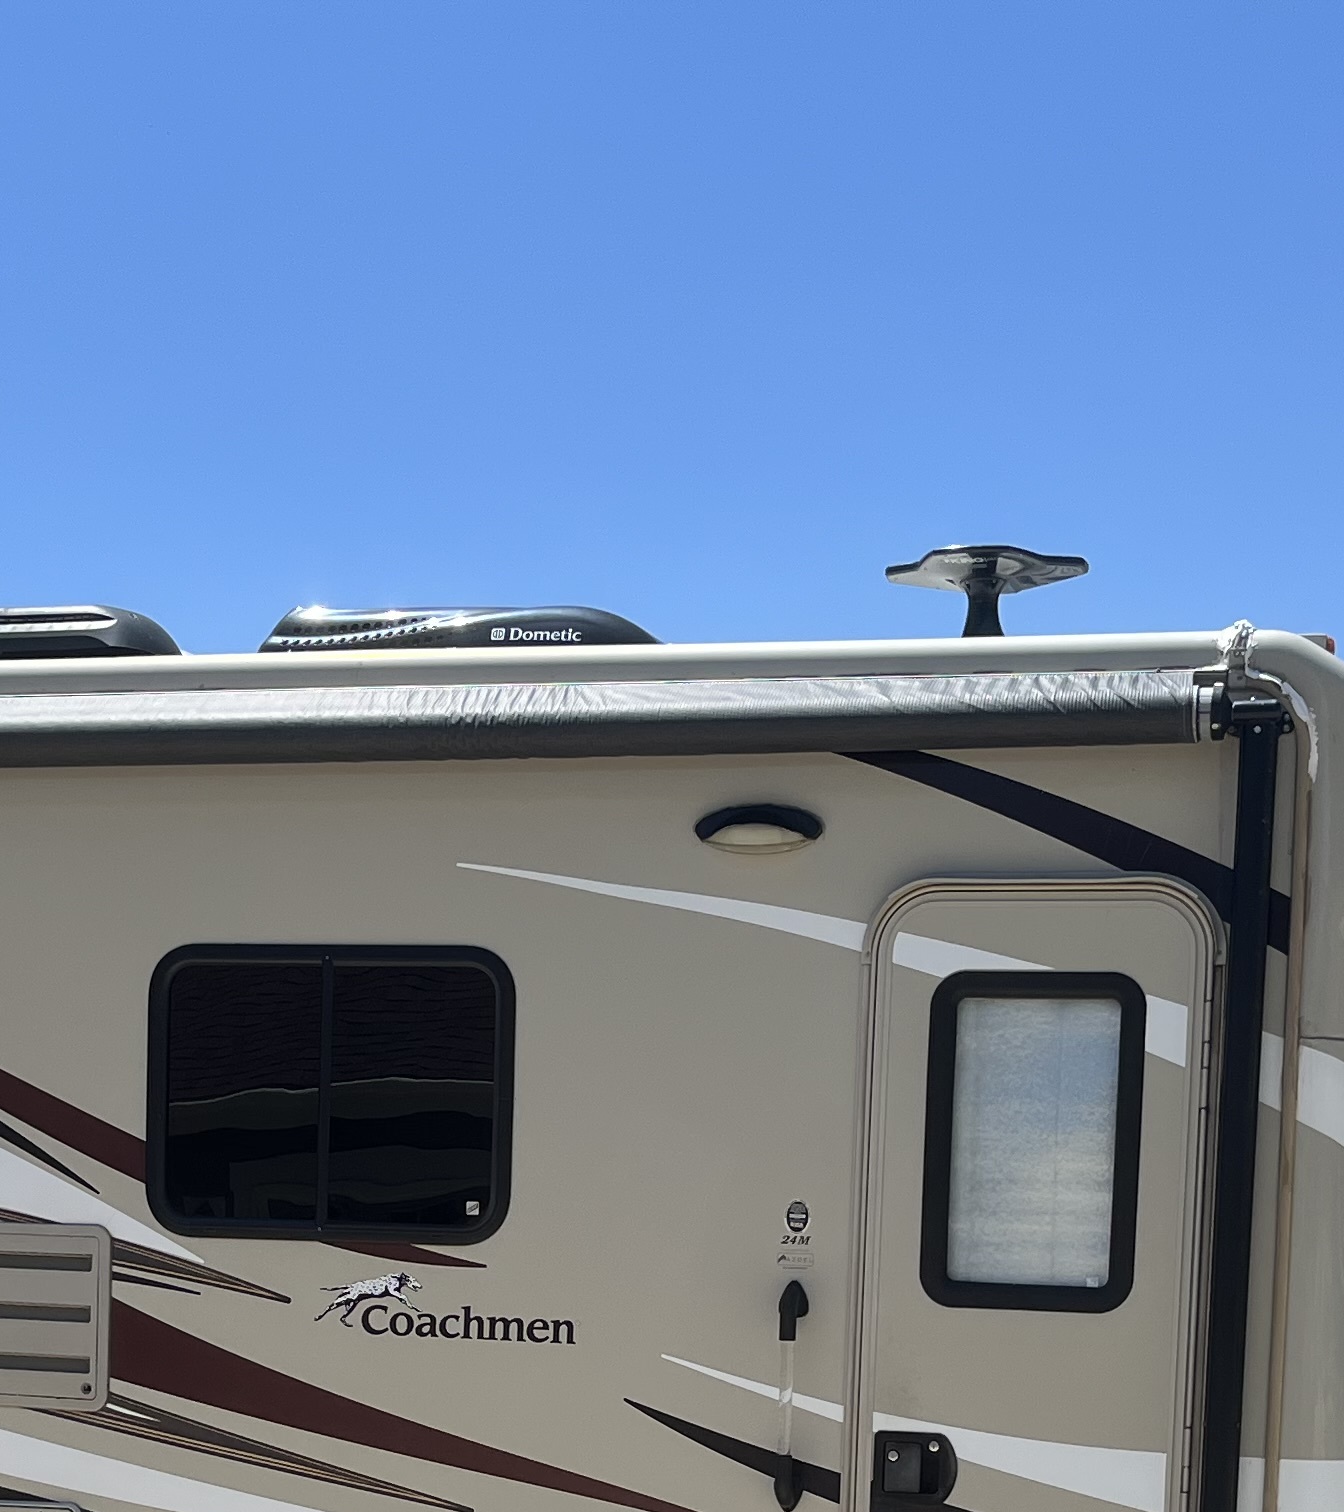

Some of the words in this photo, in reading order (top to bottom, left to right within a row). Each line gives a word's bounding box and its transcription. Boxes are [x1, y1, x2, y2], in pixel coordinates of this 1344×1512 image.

[509, 627, 583, 642] Dometic
[780, 1234, 811, 1246] 24M
[361, 1304, 576, 1345] Coachmen
